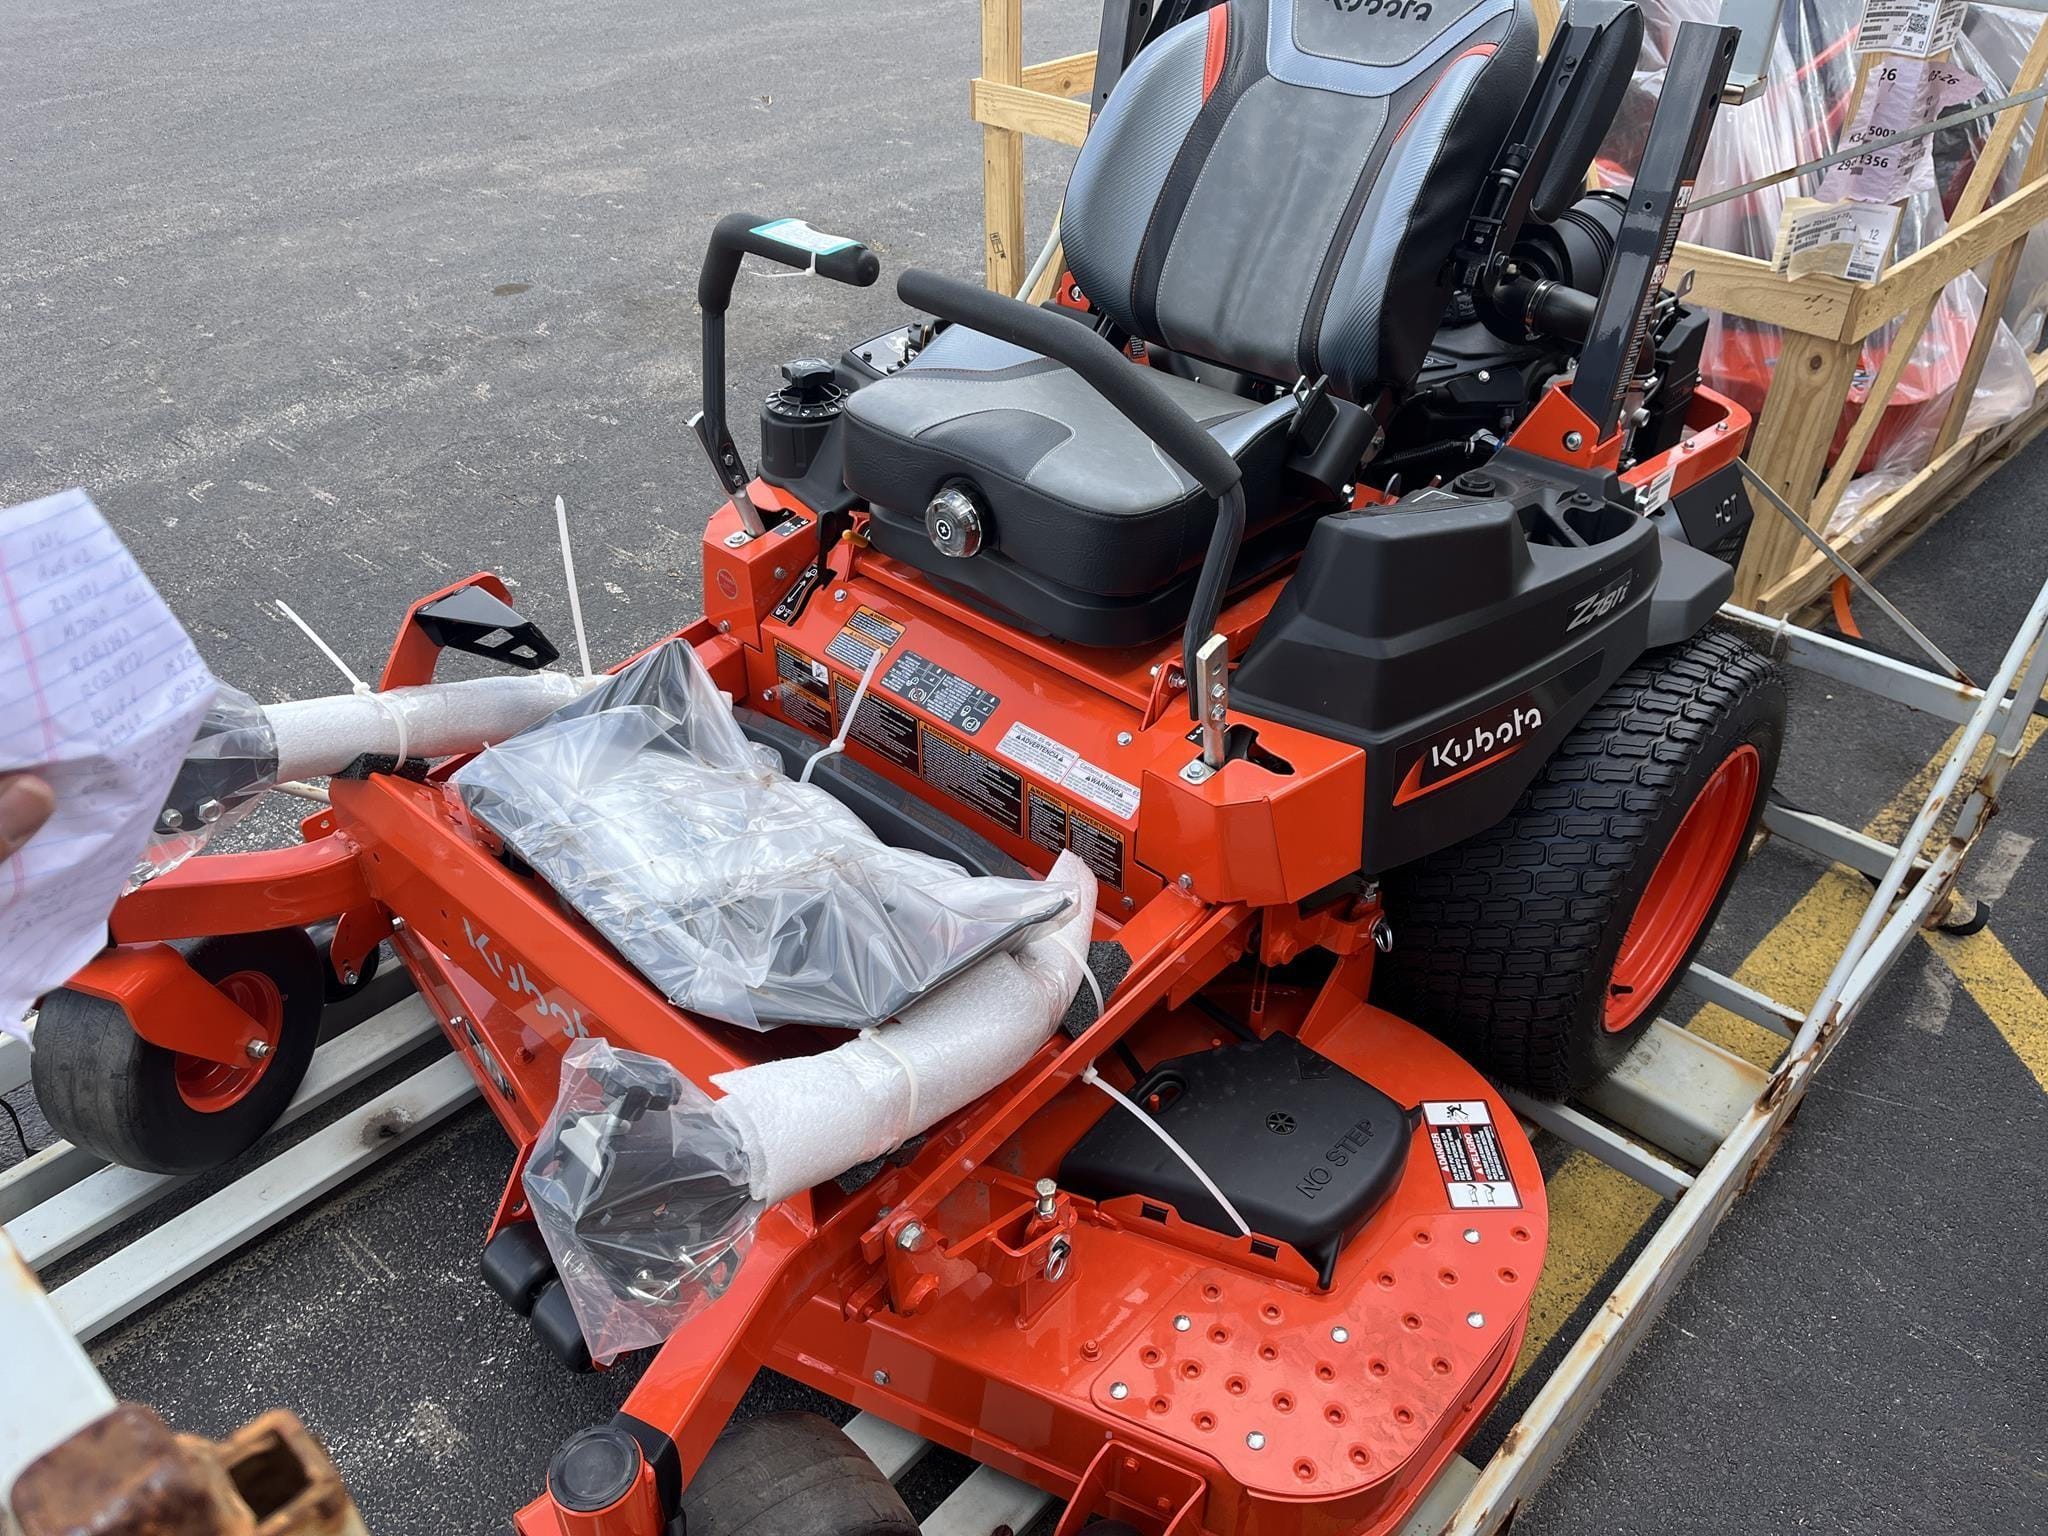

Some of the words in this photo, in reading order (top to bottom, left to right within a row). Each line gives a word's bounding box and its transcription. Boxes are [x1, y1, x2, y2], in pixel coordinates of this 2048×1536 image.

[1870, 229, 1880, 240] 12
[928, 726, 966, 752] ADVERTENCIA
[1021, 736, 1059, 760] ADVERTENCIA
[1431, 707, 1543, 768] Kubota
[1090, 776, 1120, 797] WARNING
[1077, 812, 1122, 841] ADVERTENCIA
[462, 916, 590, 1039] Kubot
[1295, 1166, 1333, 1200] NO
[1326, 1119, 1376, 1168] STEP
[1431, 1132, 1448, 1167] DANGER
[1464, 1132, 1483, 1168] PELIGRO
